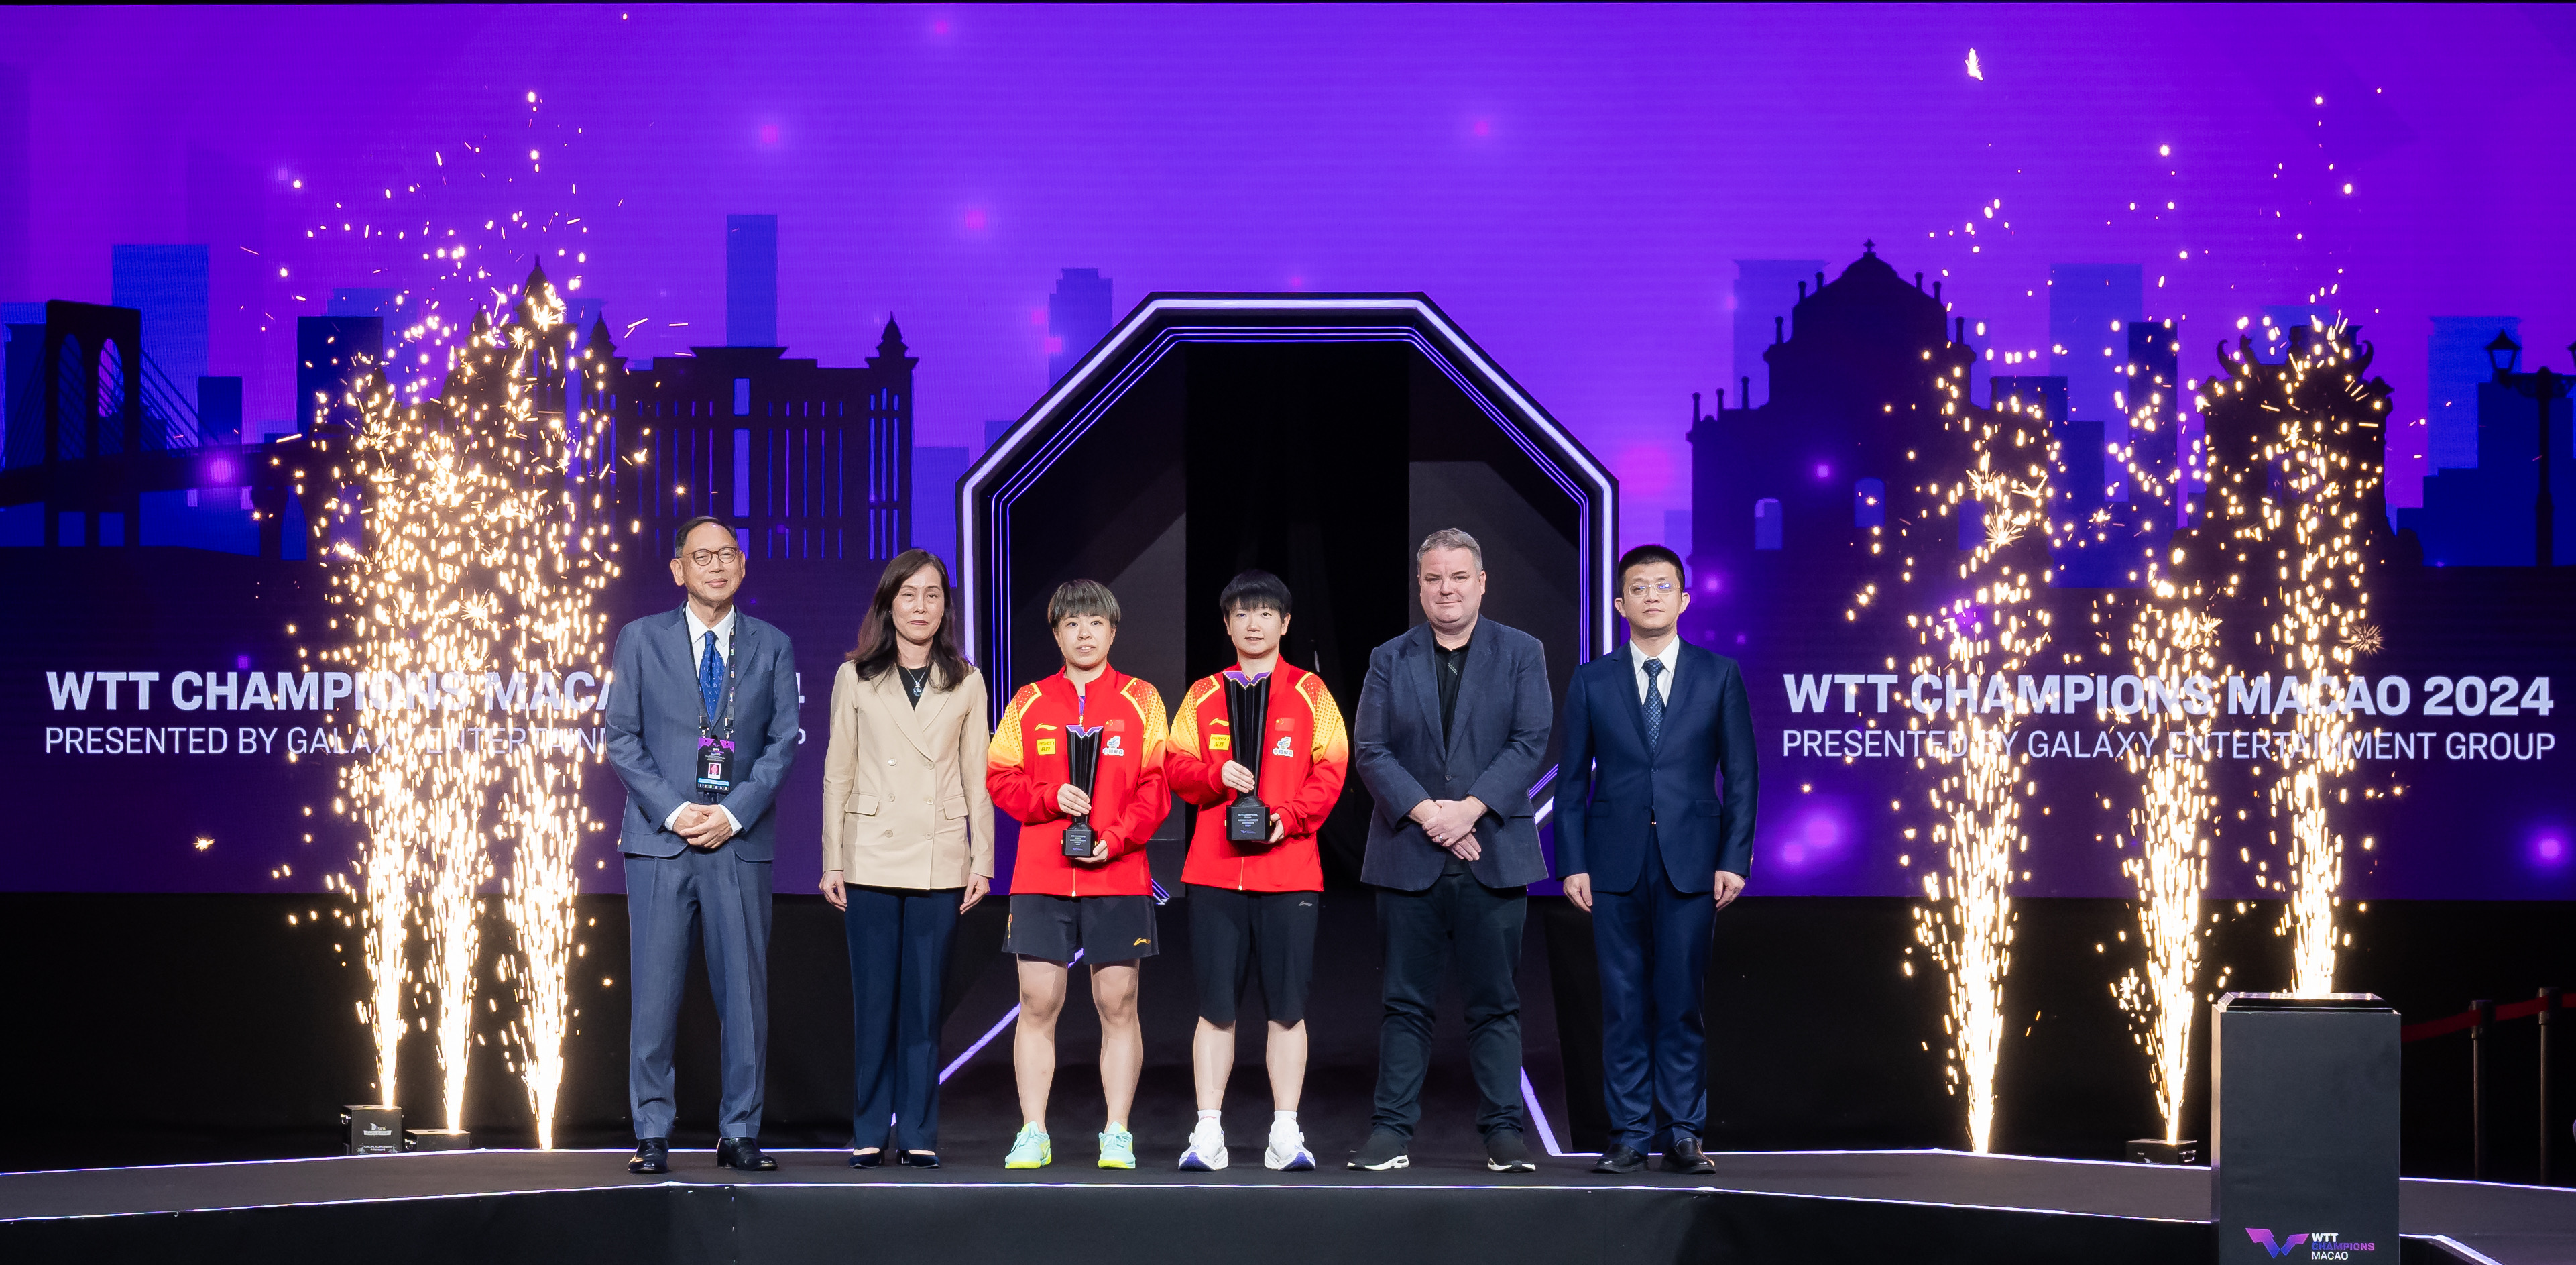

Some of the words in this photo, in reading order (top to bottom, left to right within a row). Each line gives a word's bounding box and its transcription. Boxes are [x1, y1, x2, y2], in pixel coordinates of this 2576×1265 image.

[46, 671, 160, 710] WTT
[172, 671, 471, 711] CHAMPIONS
[484, 671, 610, 711] MAC
[1783, 673, 1898, 713] WTT
[1911, 673, 2214, 715] CHAMPIONS
[2227, 675, 2410, 716] MACAO
[2423, 675, 2554, 716] 2024
[46, 727, 227, 754] PRESENTED
[239, 727, 276, 754] BY
[288, 726, 416, 755] GALAXY
[1783, 730, 1968, 757] PRESENTED
[2028, 730, 2156, 759] GALAXY
[2168, 731, 2437, 759] ENTERTAINMENT
[2445, 731, 2555, 760] GROUP
[2311, 1233, 2339, 1242] WTT
[2311, 1242, 2375, 1251] CHAMPIONS
[2311, 1251, 2349, 1260] MACAO
